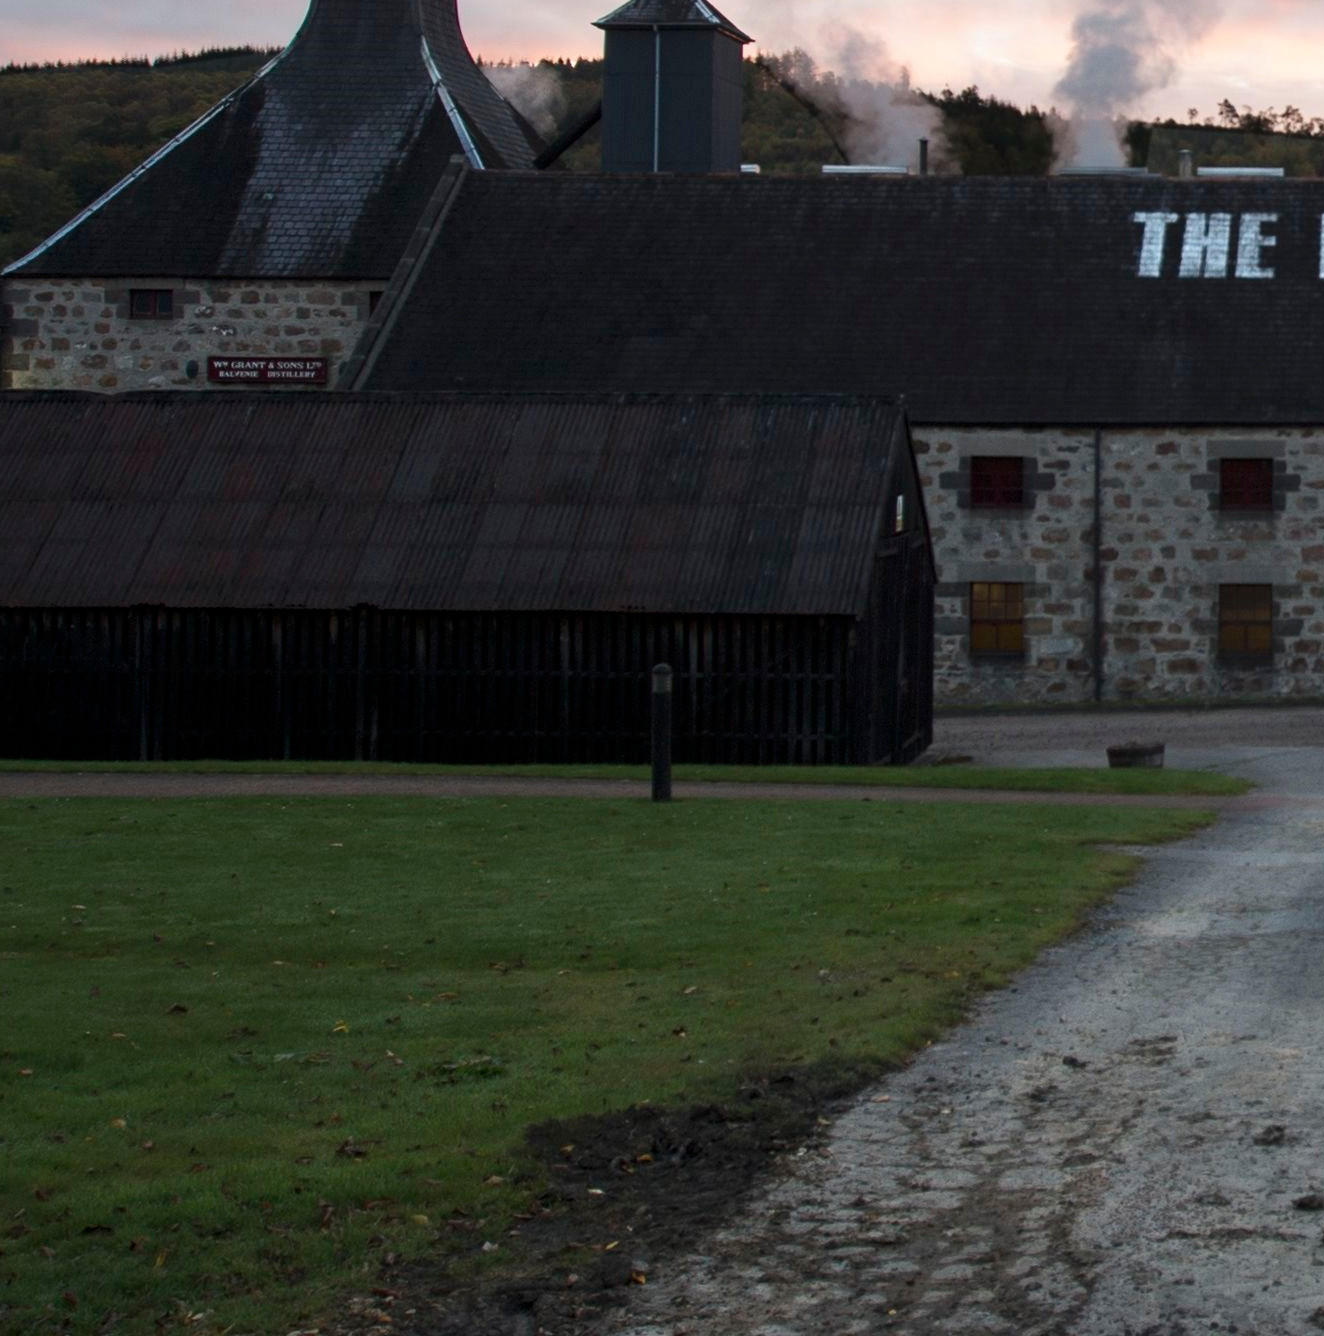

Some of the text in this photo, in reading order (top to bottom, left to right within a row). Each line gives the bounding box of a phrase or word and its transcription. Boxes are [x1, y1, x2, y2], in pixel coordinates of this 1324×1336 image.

[1133, 211, 1279, 279] THE
[231, 361, 266, 369] GRANT
[268, 361, 275, 369] &
[277, 361, 304, 369] SONS
